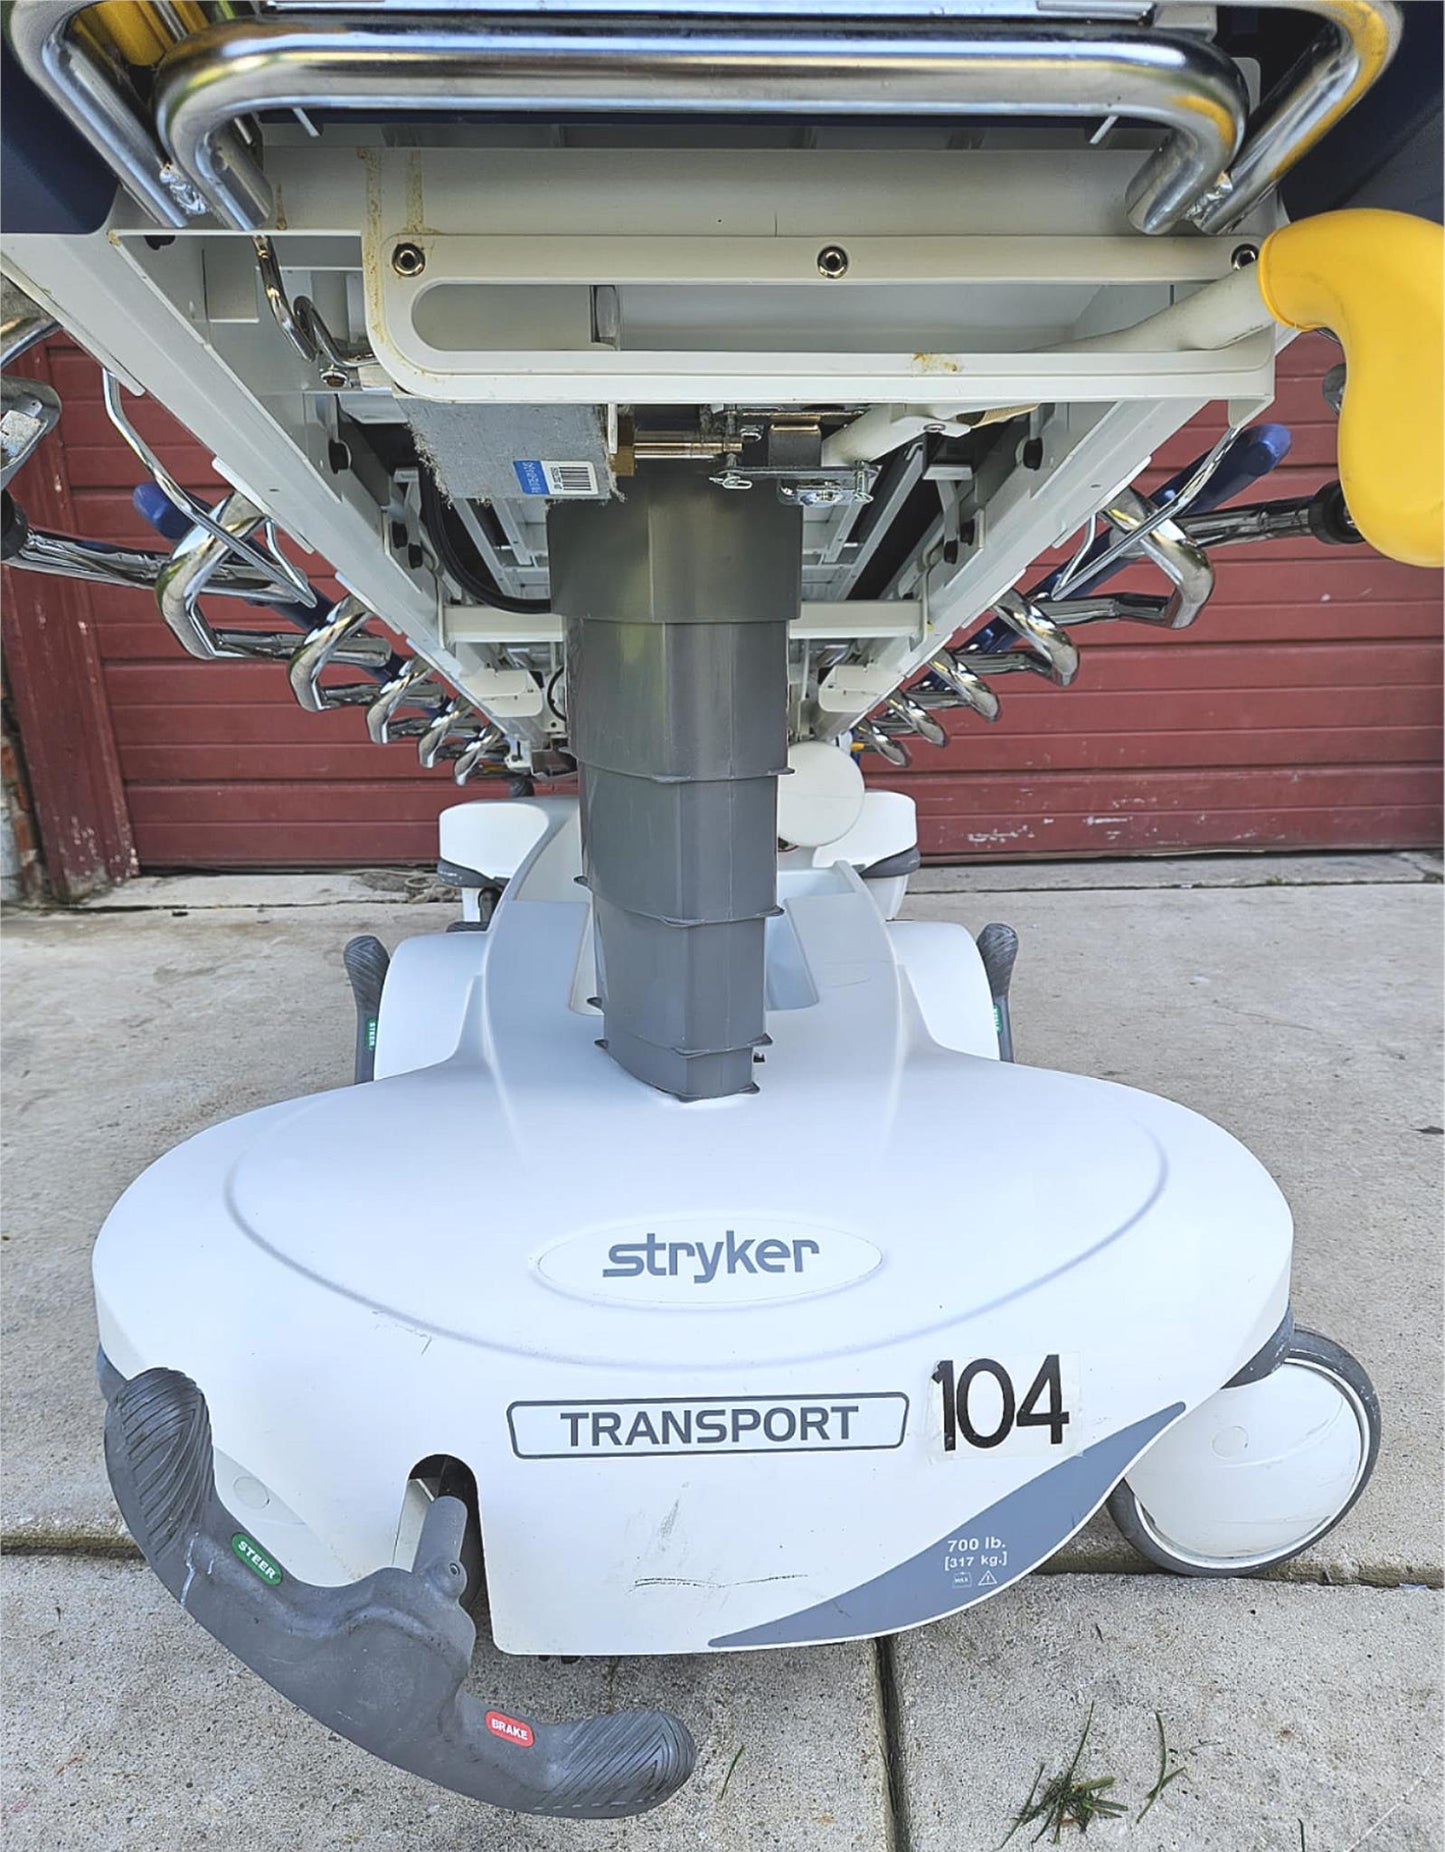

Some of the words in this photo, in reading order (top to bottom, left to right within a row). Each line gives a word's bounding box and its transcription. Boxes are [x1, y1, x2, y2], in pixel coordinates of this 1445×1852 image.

[602, 1230, 820, 1284] stryker
[931, 1354, 1070, 1452] 104
[560, 1405, 859, 1447] TRANSPORT
[237, 1540, 276, 1579] STEER
[944, 1556, 975, 1571] [317
[980, 1551, 1008, 1567] kg.]
[947, 1537, 979, 1553] 700
[984, 1536, 1006, 1549] lb.
[491, 1718, 529, 1741] BRAKE
